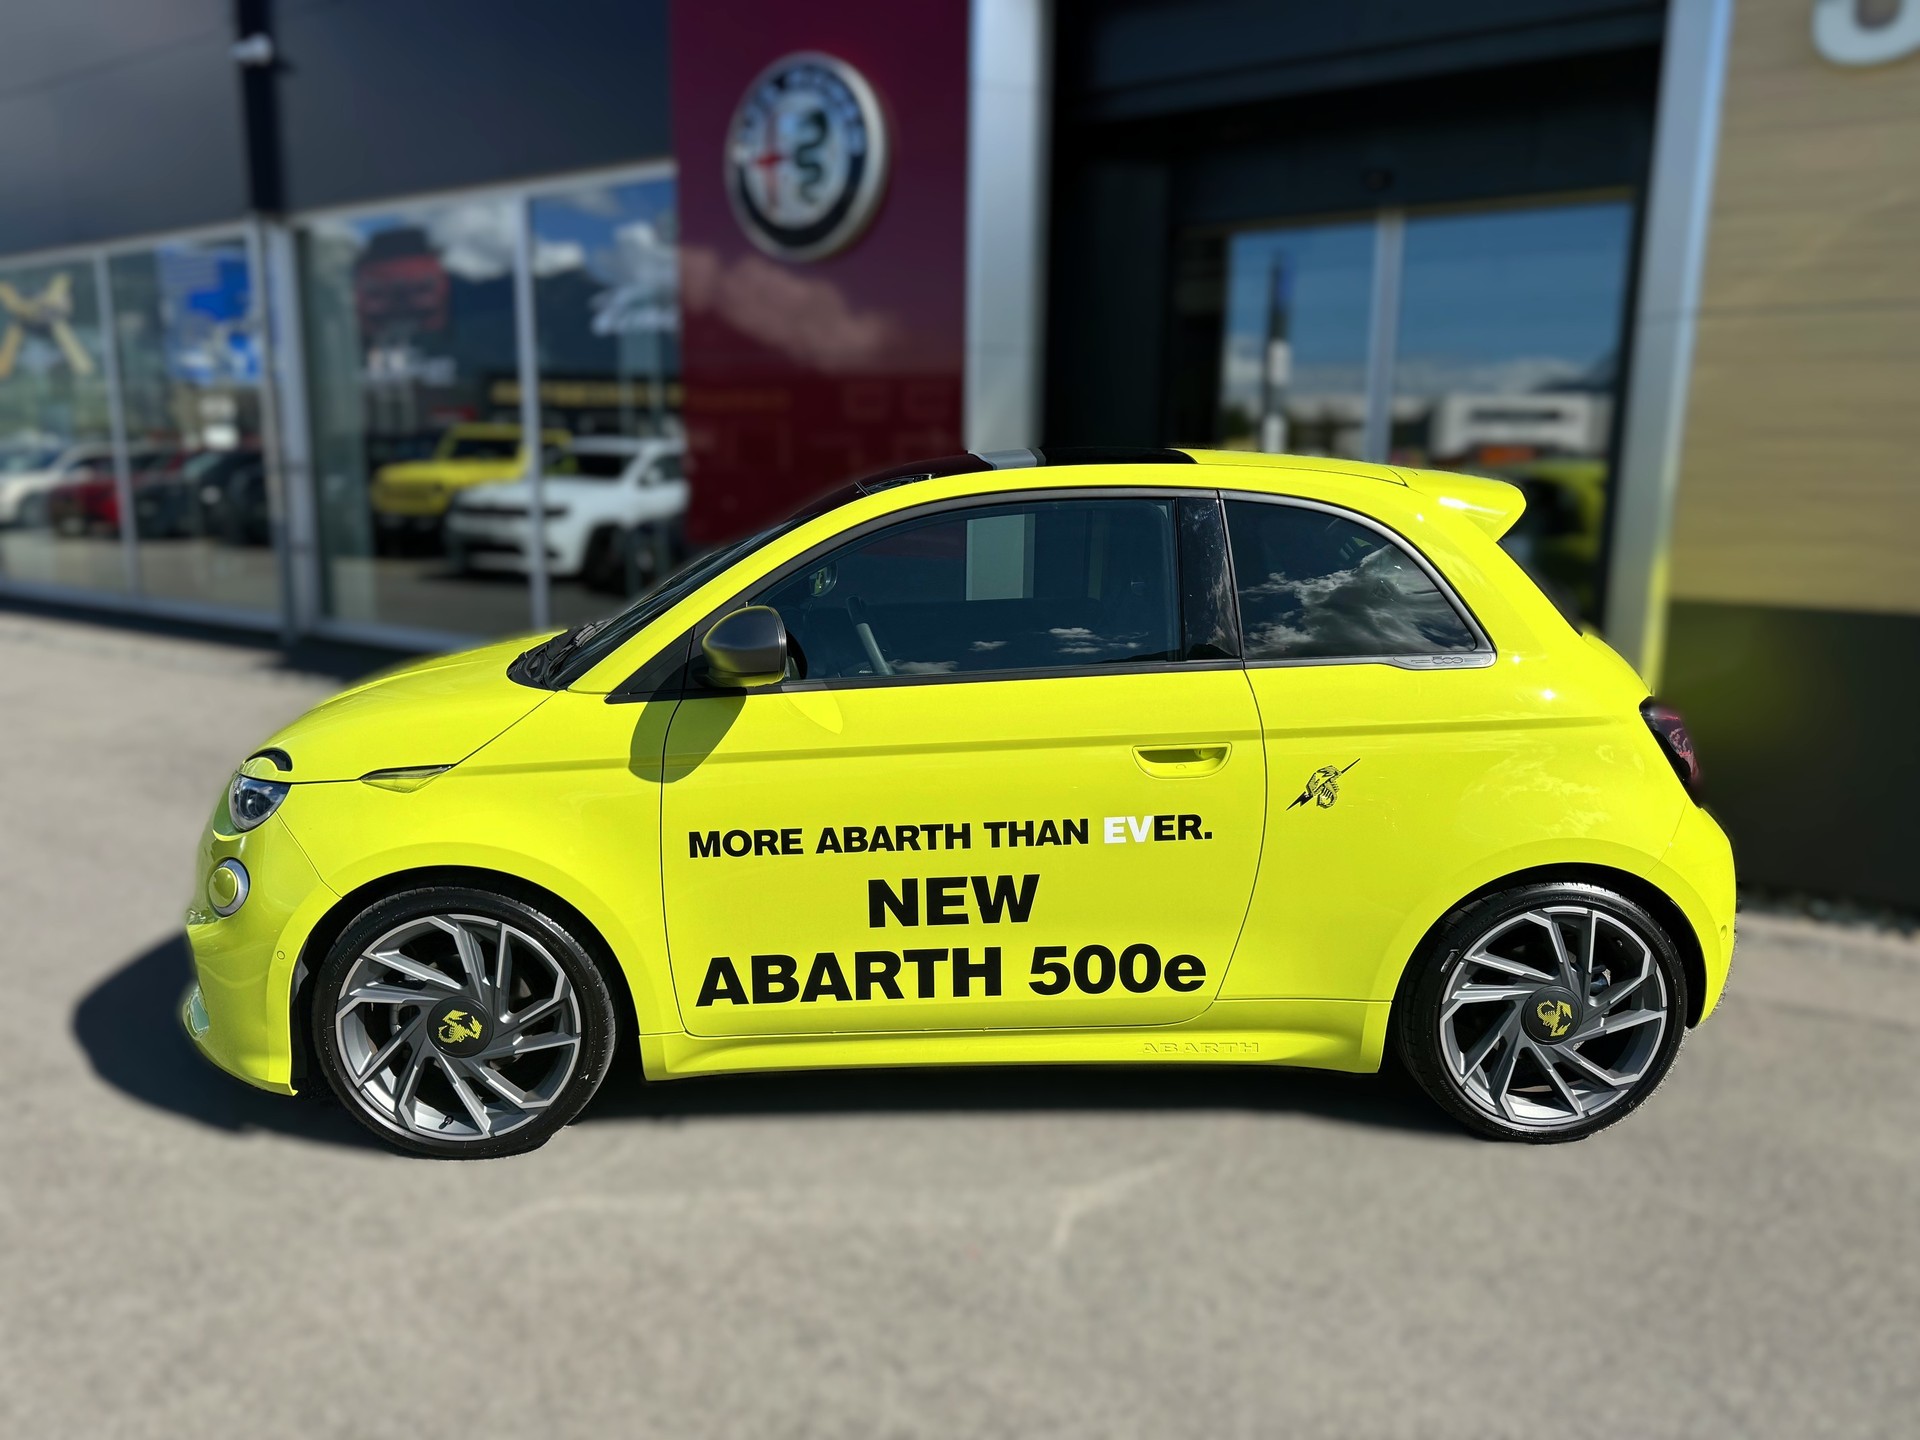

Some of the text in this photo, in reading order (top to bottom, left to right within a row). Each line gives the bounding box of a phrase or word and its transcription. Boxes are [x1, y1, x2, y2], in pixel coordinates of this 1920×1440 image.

[1432, 656, 1463, 664] 500
[688, 813, 1213, 858] MORE ABARTH THAN EVER.
[867, 873, 1041, 928] NEW
[695, 943, 1207, 1008] ABARTH 500e
[1142, 1043, 1259, 1053] ABARTH
